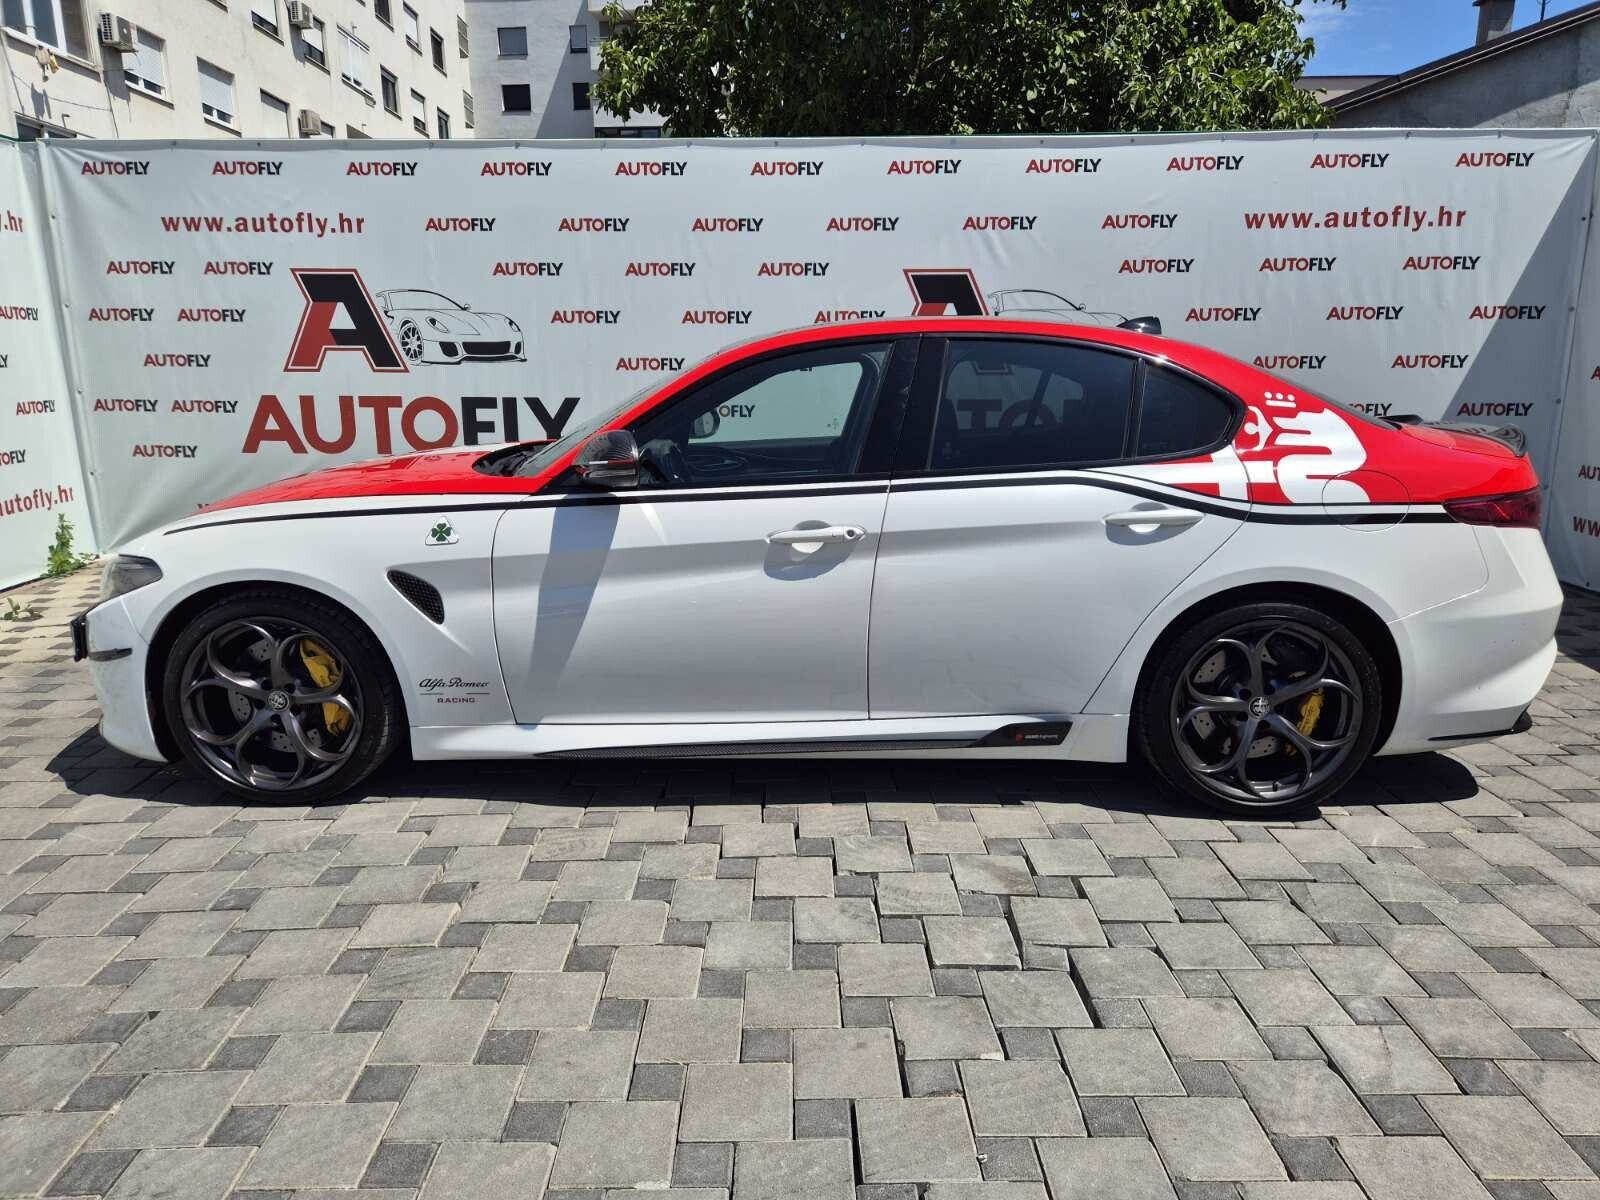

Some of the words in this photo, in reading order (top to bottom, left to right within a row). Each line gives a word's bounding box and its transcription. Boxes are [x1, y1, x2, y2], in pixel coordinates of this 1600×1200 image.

[887, 160, 961, 174] AUTOFLY
[1026, 159, 1102, 173] AUTOFLY
[1166, 156, 1244, 171] AUTOFLY
[1310, 153, 1389, 168] AUTOFLY
[1456, 153, 1534, 167] AUTOFLY
[81, 162, 150, 175] AUTOFLY
[212, 161, 283, 175] AUTOFLY
[346, 162, 418, 176] AUTOFLY
[481, 162, 552, 176] AUTOFLY
[615, 162, 687, 176] AUTOFLY
[751, 161, 823, 176] AUTOFLY
[161, 212, 364, 238] www.autofly.hr
[425, 218, 496, 231] AUTOFLY
[558, 218, 629, 232] AUTOFLY
[692, 218, 763, 232] AUTOFLY
[827, 217, 899, 231] AUTOFLY
[963, 216, 1037, 230] AUTOFLY
[1102, 214, 1178, 229] AUTOFLY
[1245, 205, 1466, 232] www.autofly.hr
[107, 261, 175, 274] AUTOFLY
[204, 262, 273, 275] AUTOFLY
[493, 262, 563, 276] AUTOFLY
[625, 263, 696, 276] AUTOFLY
[758, 263, 829, 276] AUTOFLY
[1118, 259, 1194, 273] AUTOFLY
[1259, 257, 1336, 271] AUTOFLY
[1403, 256, 1480, 270] AUTOFLY
[89, 308, 154, 321] AUTOFLY
[178, 309, 246, 322] AUTOFLY
[551, 311, 621, 324] AUTOFLY
[682, 311, 752, 324] AUTOFLY
[1185, 308, 1262, 321] AUTOFLY
[1326, 306, 1404, 320] AUTOFLY
[1469, 306, 1545, 319] AUTOFLY
[144, 354, 211, 367] AUTOFLY
[616, 358, 684, 371] AUTOFLY
[1253, 356, 1326, 369] AUTOFLY
[1392, 355, 1468, 368] AUTOFLY
[16, 400, 55, 415] AUTOFLY
[94, 399, 158, 412] AUTOFLY
[171, 400, 238, 413] AUTOFLY
[719, 404, 756, 418] OFLY
[1456, 403, 1533, 416] AUTOFLY
[242, 395, 580, 455] AUTOFLY
[0, 449, 26, 466] OFLY
[133, 445, 197, 458] AUTOFLY
[0, 485, 74, 516] utofly.hr
[419, 678, 446, 692] Alfa
[449, 677, 489, 688] Romeo
